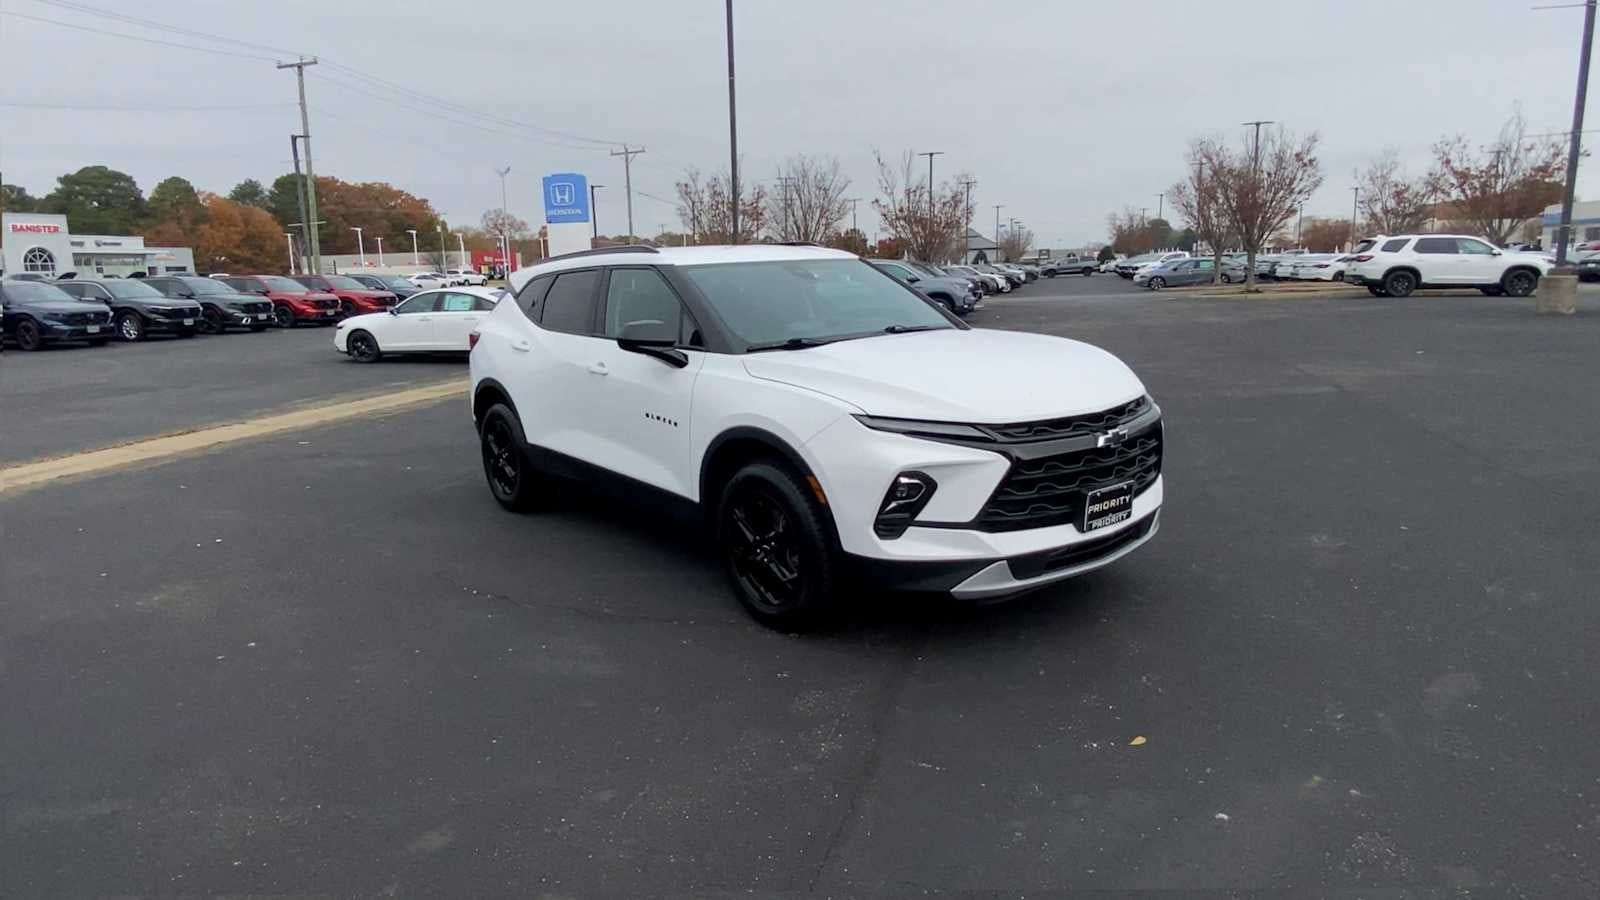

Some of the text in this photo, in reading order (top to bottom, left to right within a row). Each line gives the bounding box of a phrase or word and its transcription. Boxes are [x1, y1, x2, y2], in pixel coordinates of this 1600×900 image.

[11, 224, 60, 233] BANISTER
[1088, 494, 1131, 514] PRIORITY
[1091, 511, 1128, 528] PRIORITY
